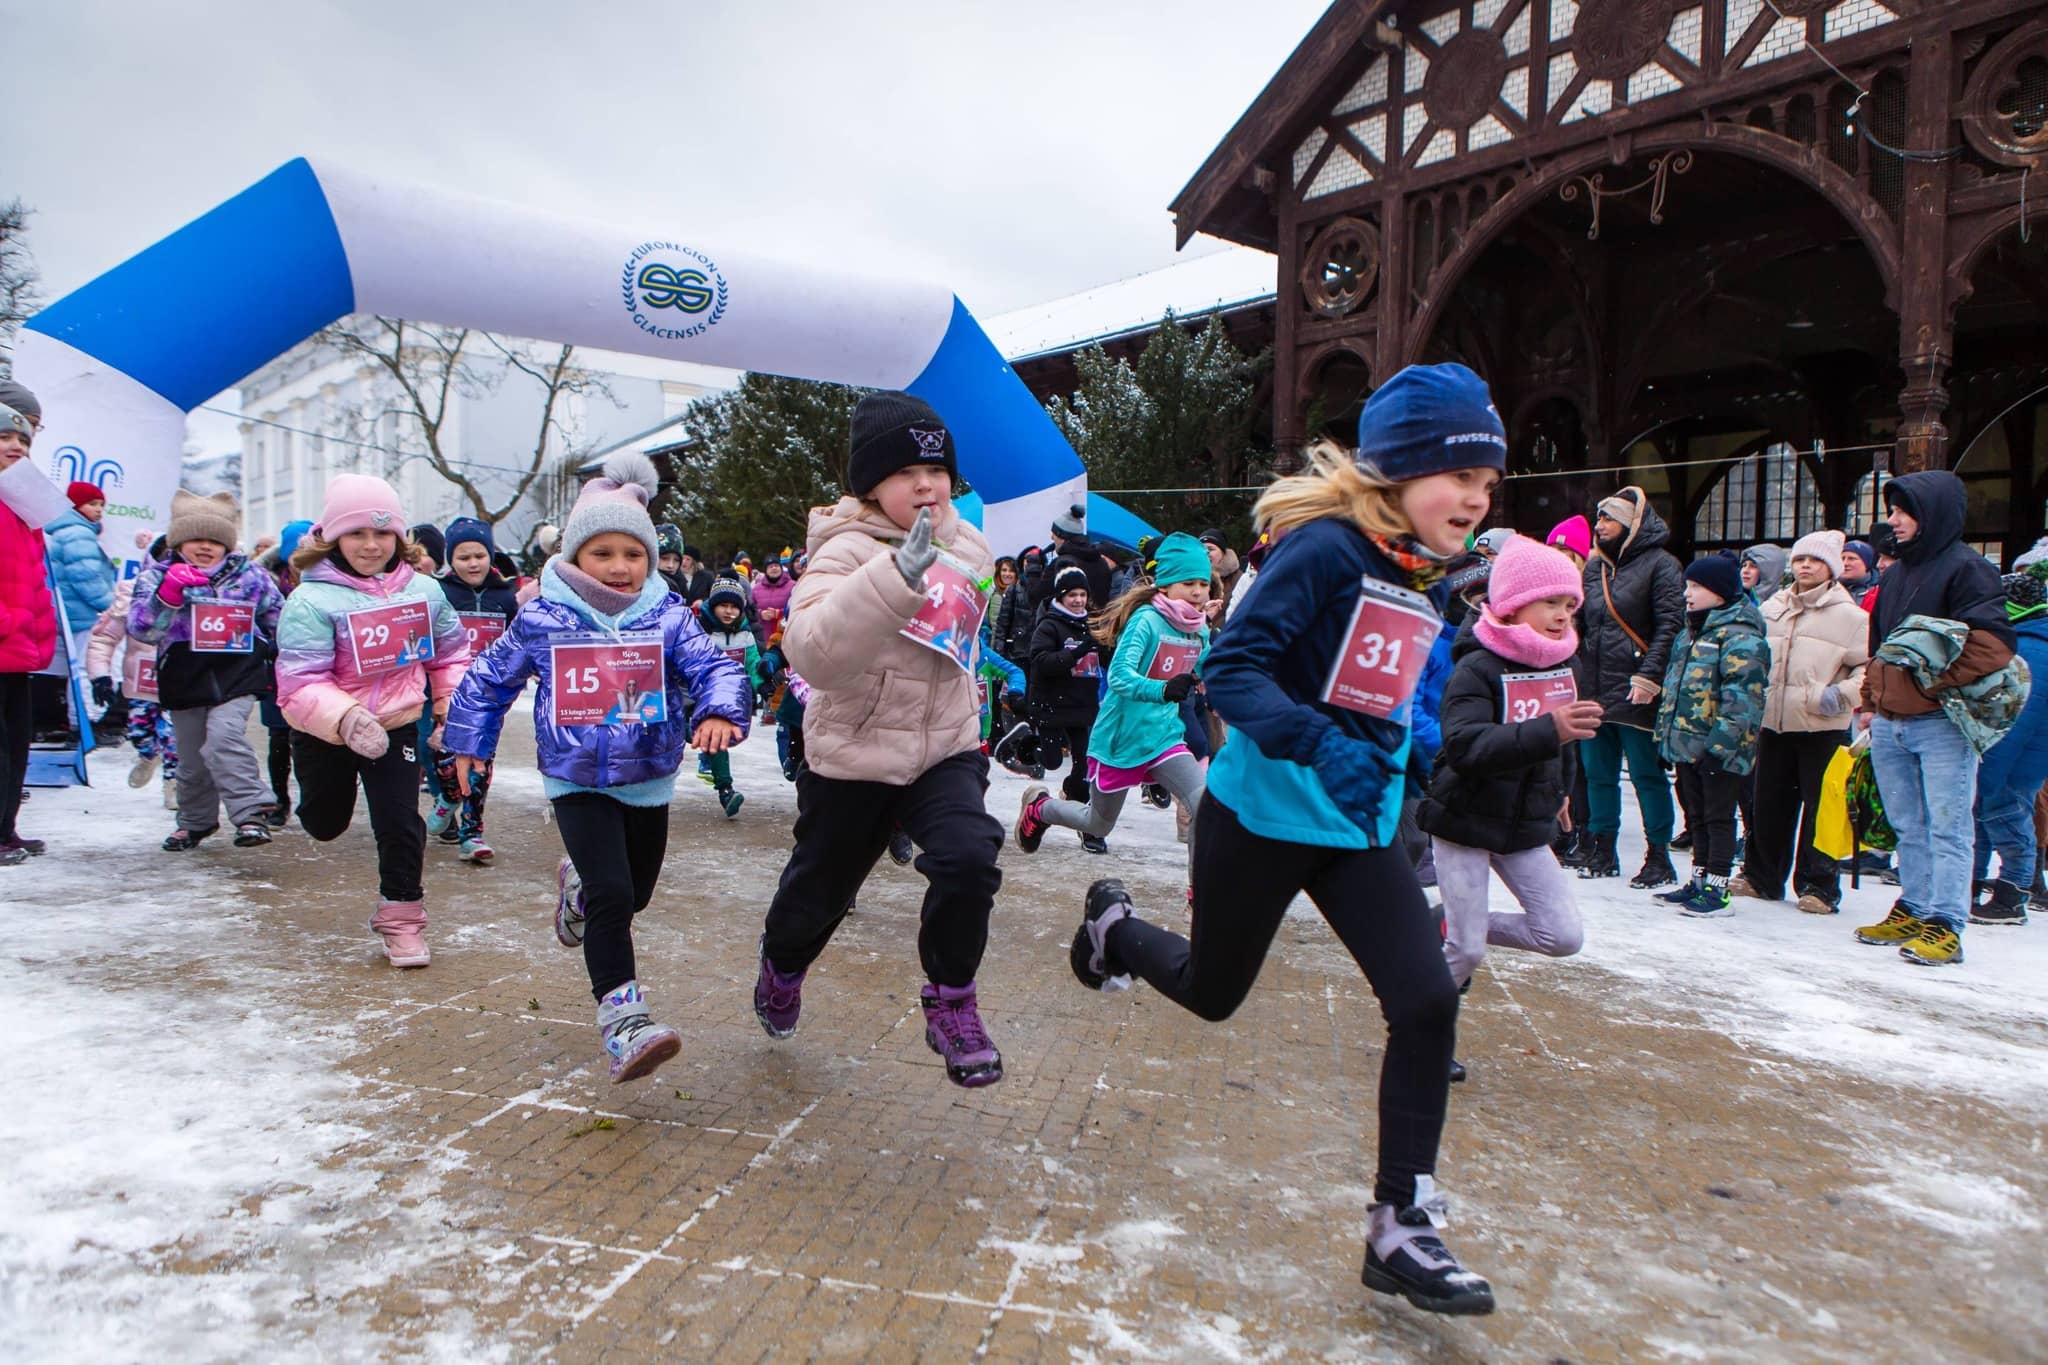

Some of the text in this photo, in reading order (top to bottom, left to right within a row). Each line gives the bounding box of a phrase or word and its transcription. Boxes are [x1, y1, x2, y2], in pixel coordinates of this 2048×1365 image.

[631, 241, 718, 273] EUROREGION
[633, 313, 707, 340] GLACENSIS
[107, 503, 157, 520] ZDRÓJ
[200, 616, 225, 632] 66
[360, 624, 390, 649] 29
[1162, 656, 1175, 673] 8
[1355, 632, 1403, 675] 31
[564, 667, 600, 694] 15
[1512, 698, 1541, 723] 32
